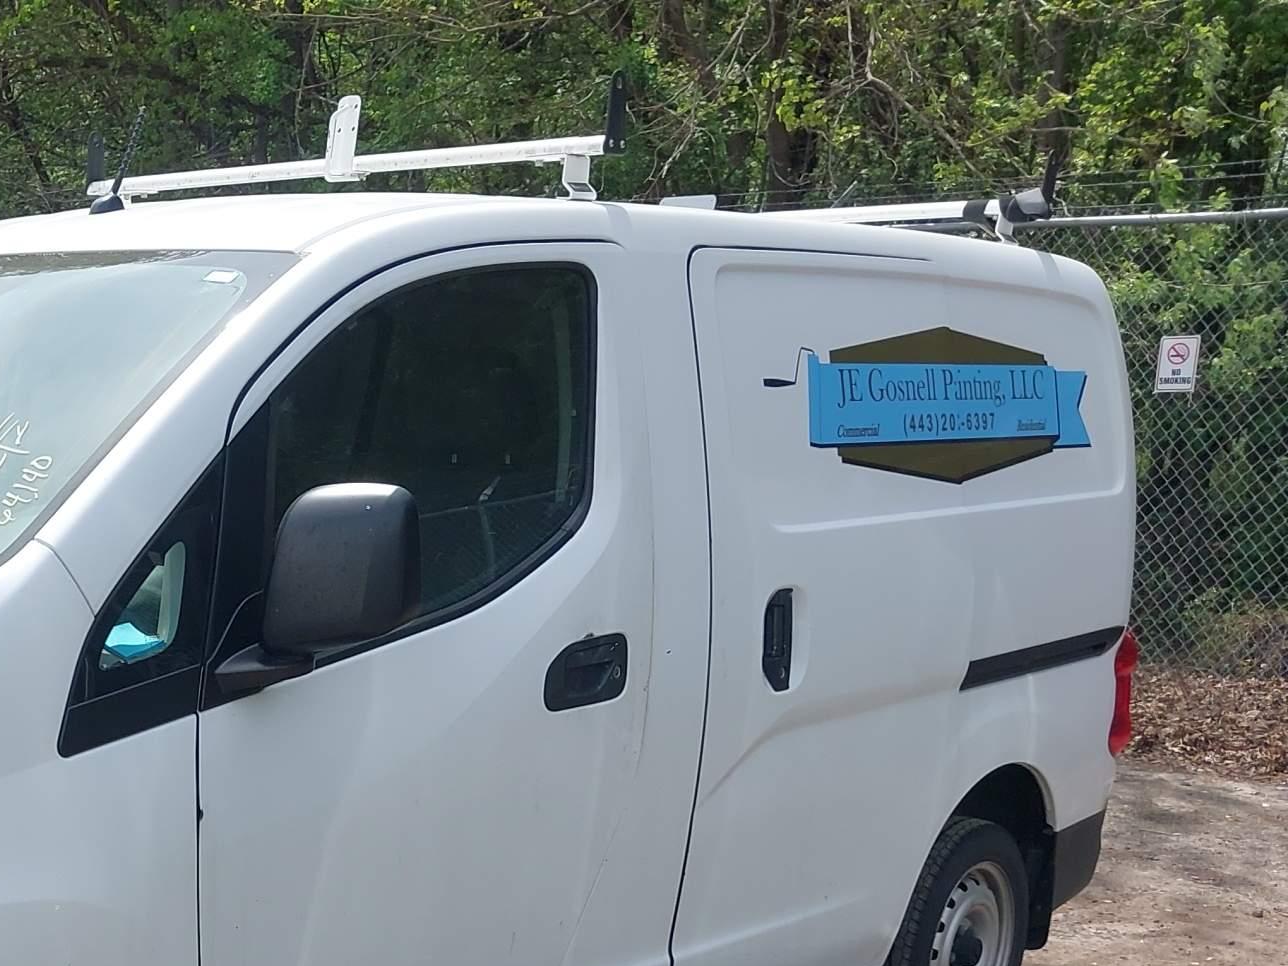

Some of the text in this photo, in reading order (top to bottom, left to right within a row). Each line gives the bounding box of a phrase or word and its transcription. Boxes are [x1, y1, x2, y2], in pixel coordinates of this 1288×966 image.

[1171, 368, 1182, 376] NO
[1159, 376, 1192, 385] SMOKING
[837, 368, 863, 408] JE
[868, 368, 937, 402] Gosnell
[1009, 369, 1044, 400] LLC
